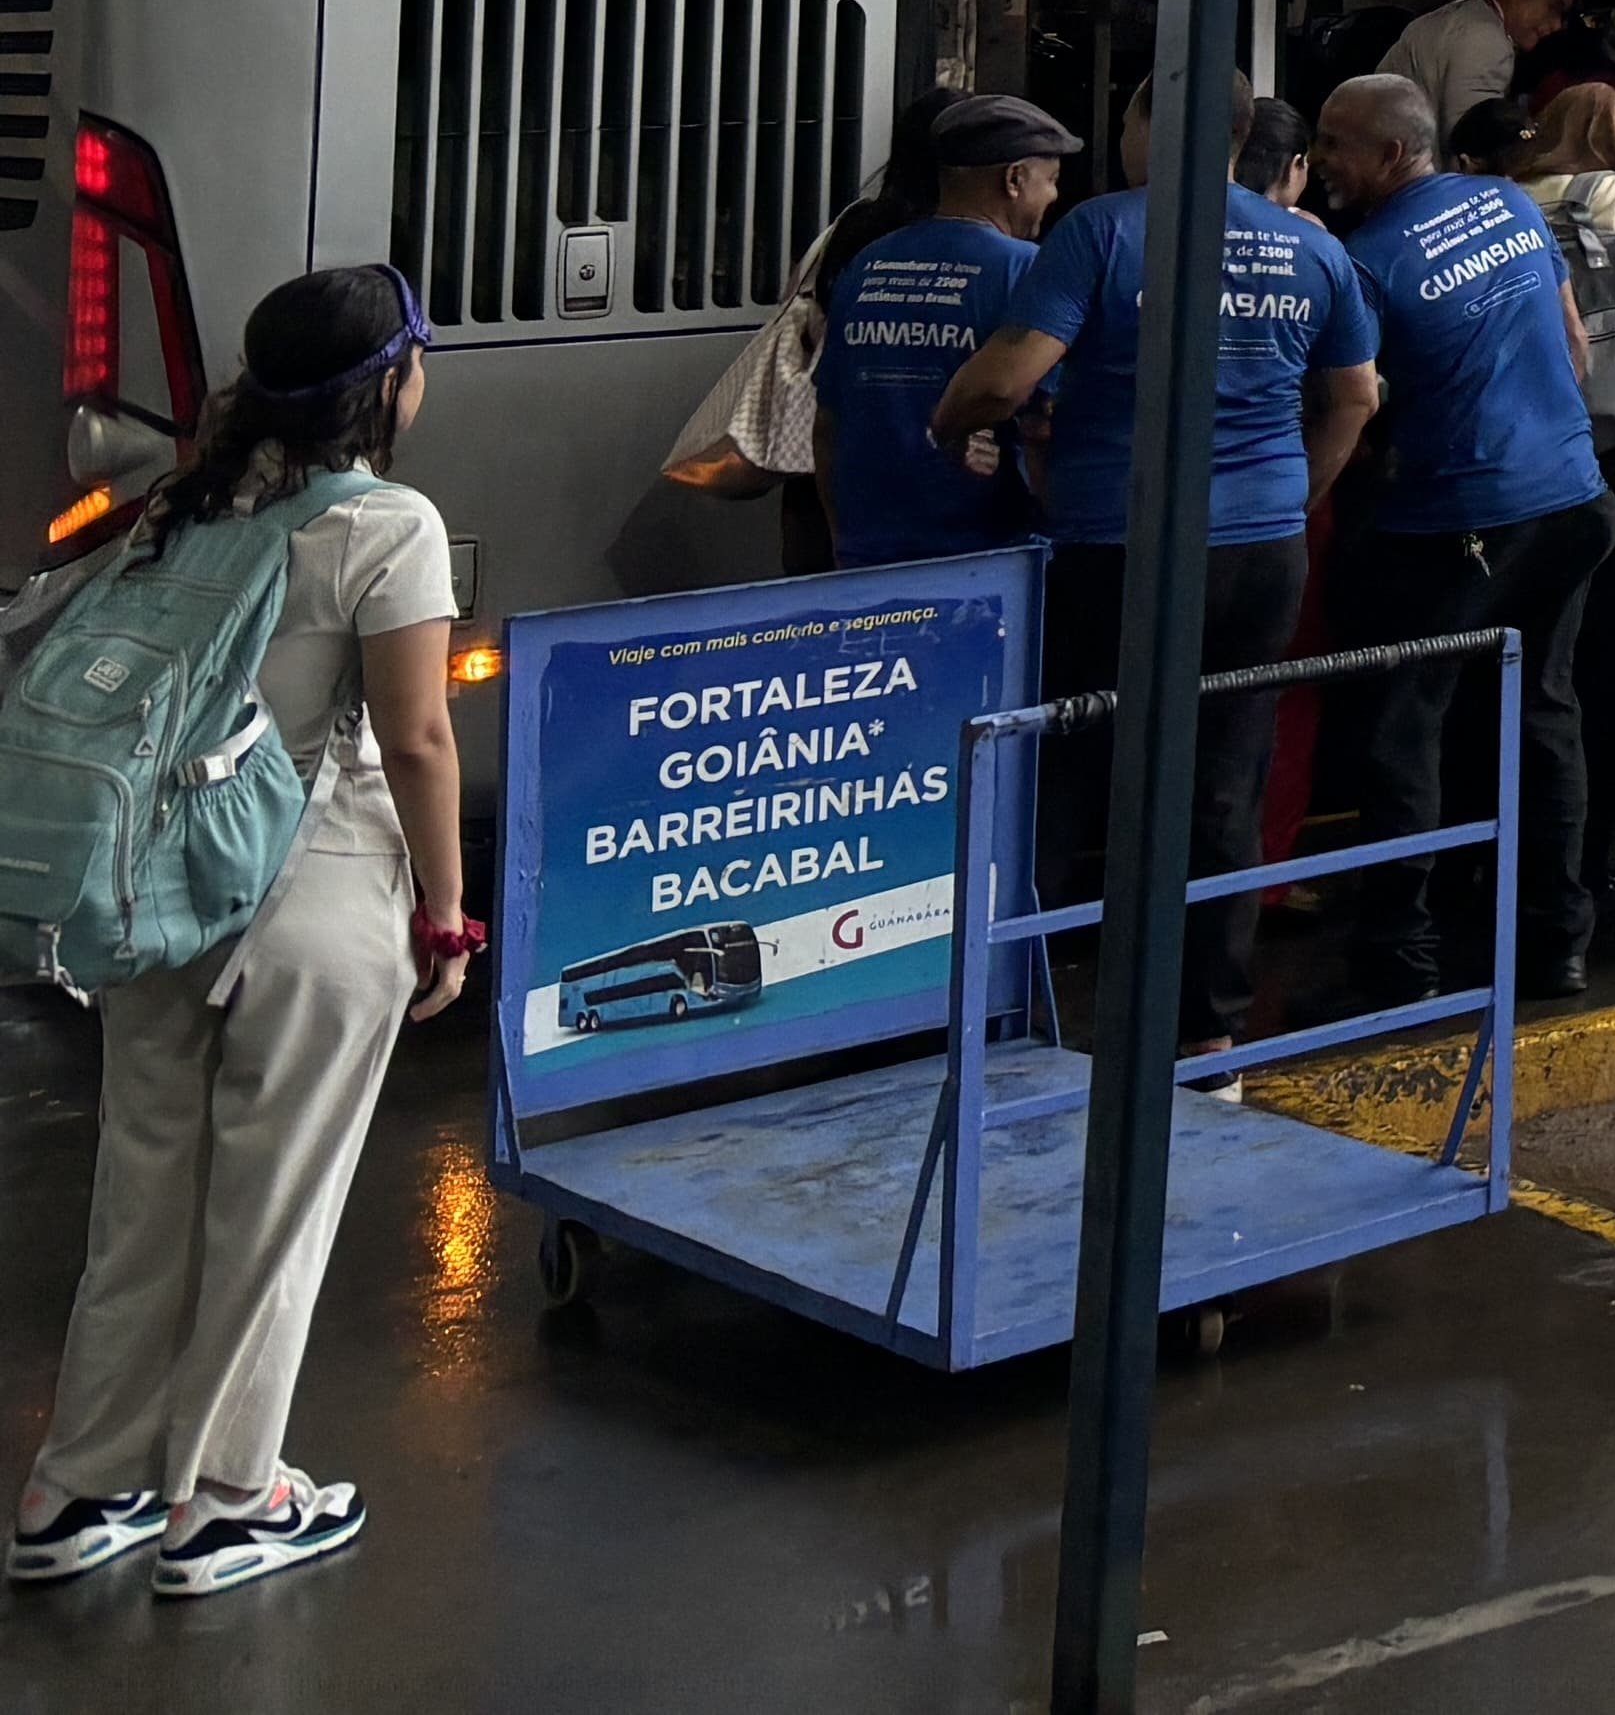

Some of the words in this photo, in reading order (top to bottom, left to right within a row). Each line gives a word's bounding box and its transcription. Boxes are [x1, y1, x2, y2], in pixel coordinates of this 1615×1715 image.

[1420, 228, 1544, 300] GUANABARA
[608, 644, 656, 666] Viaje
[660, 640, 702, 658] com
[705, 631, 748, 652] mais
[752, 620, 824, 645] conforto
[828, 620, 840, 633] e
[845, 605, 939, 631] segurança.
[628, 656, 918, 737] FORTALEZA
[585, 765, 950, 865] BARREIRINHAS
[651, 835, 885, 913] BACABAL
[831, 909, 864, 950] G
[869, 907, 952, 931] GUANABARA
